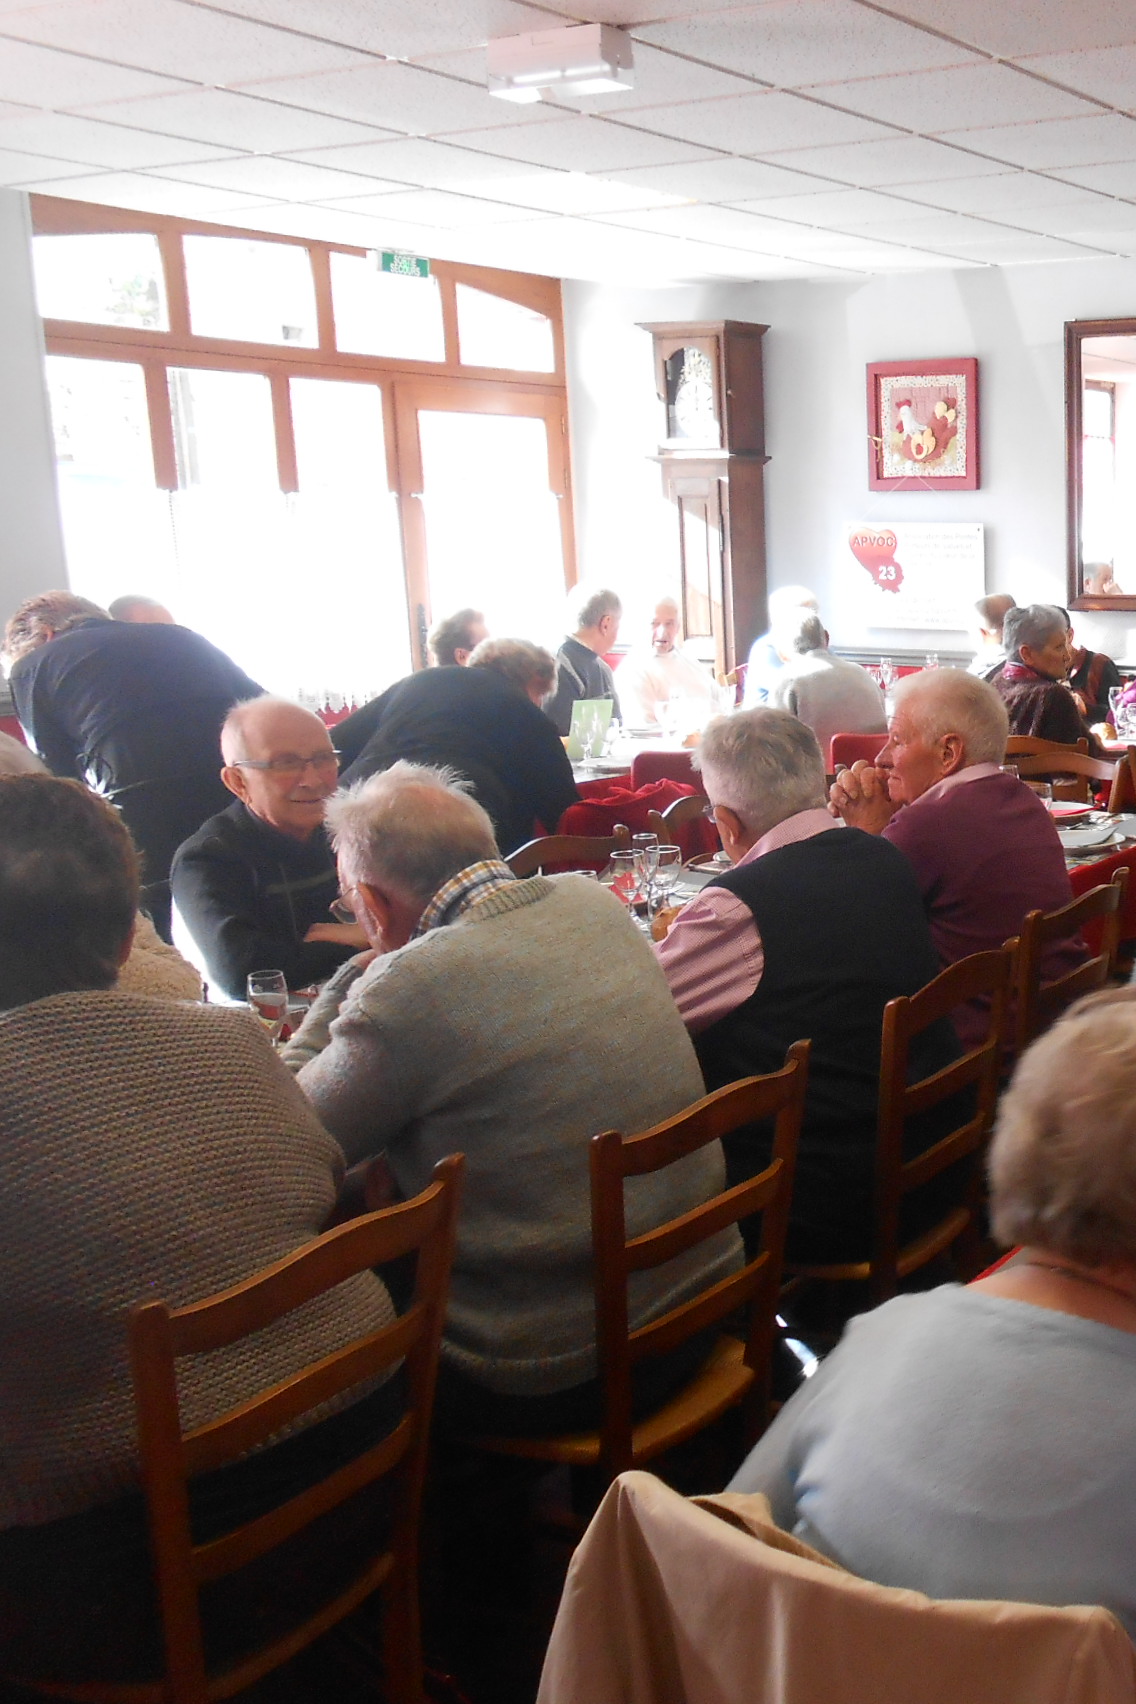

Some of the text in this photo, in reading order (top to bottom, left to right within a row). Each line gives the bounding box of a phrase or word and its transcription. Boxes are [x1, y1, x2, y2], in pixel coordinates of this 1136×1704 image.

[389, 262, 420, 276] SECOURS
[853, 536, 894, 547] APVOC
[878, 566, 896, 580] 23
